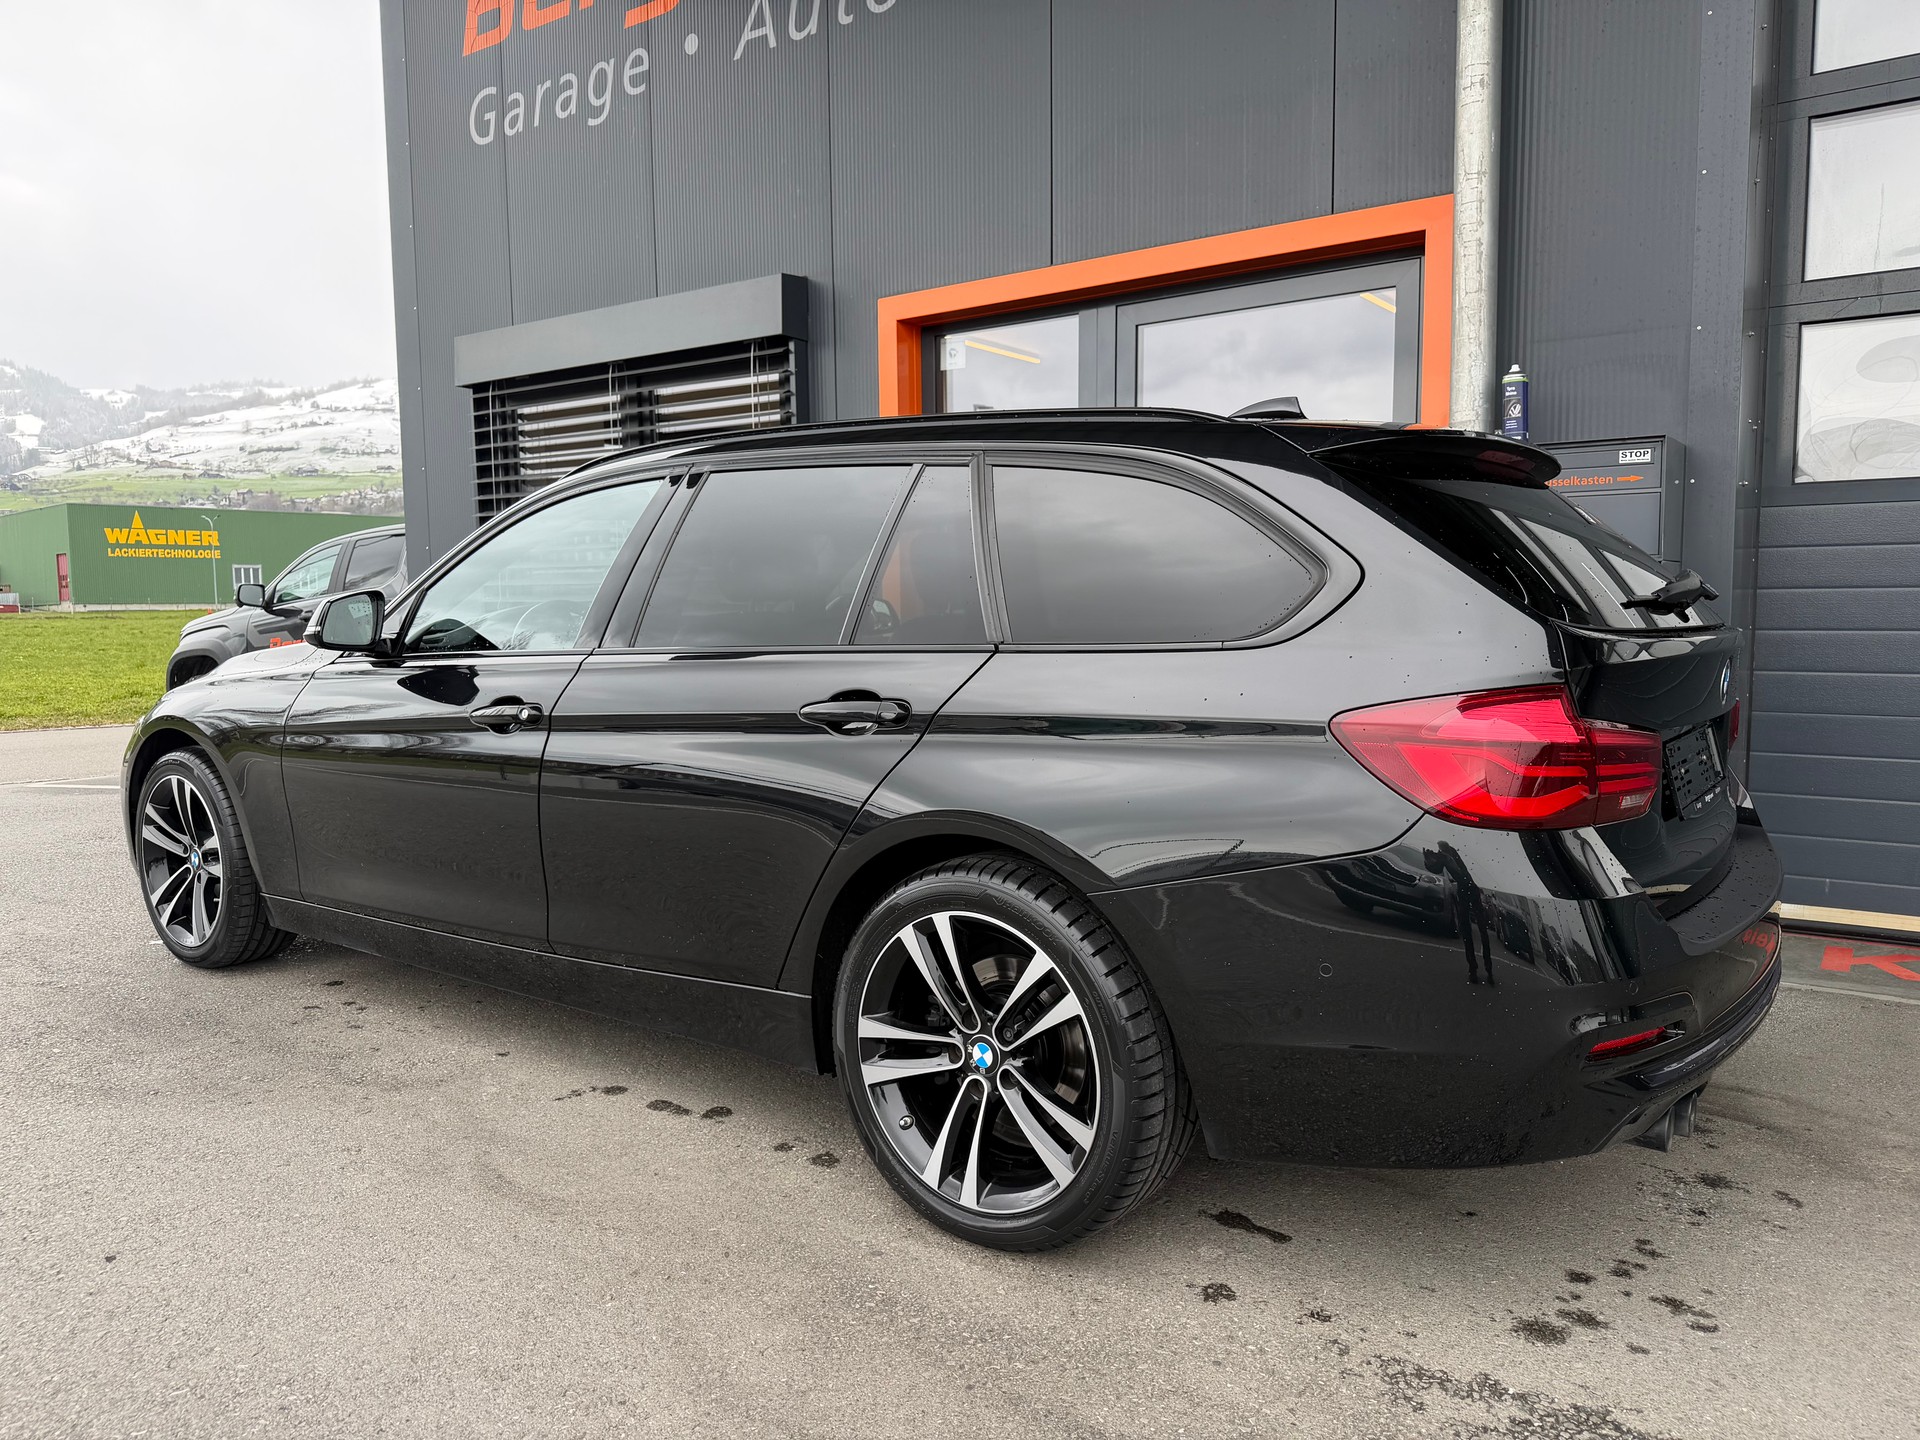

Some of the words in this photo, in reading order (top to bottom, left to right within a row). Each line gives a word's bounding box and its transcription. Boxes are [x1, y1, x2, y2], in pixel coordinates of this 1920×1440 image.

[469, 47, 649, 146] Garage
[1621, 450, 1650, 459] STOP
[104, 517, 221, 547] WAGNER
[107, 547, 221, 559] LACKIERTECHNOLOGIE
